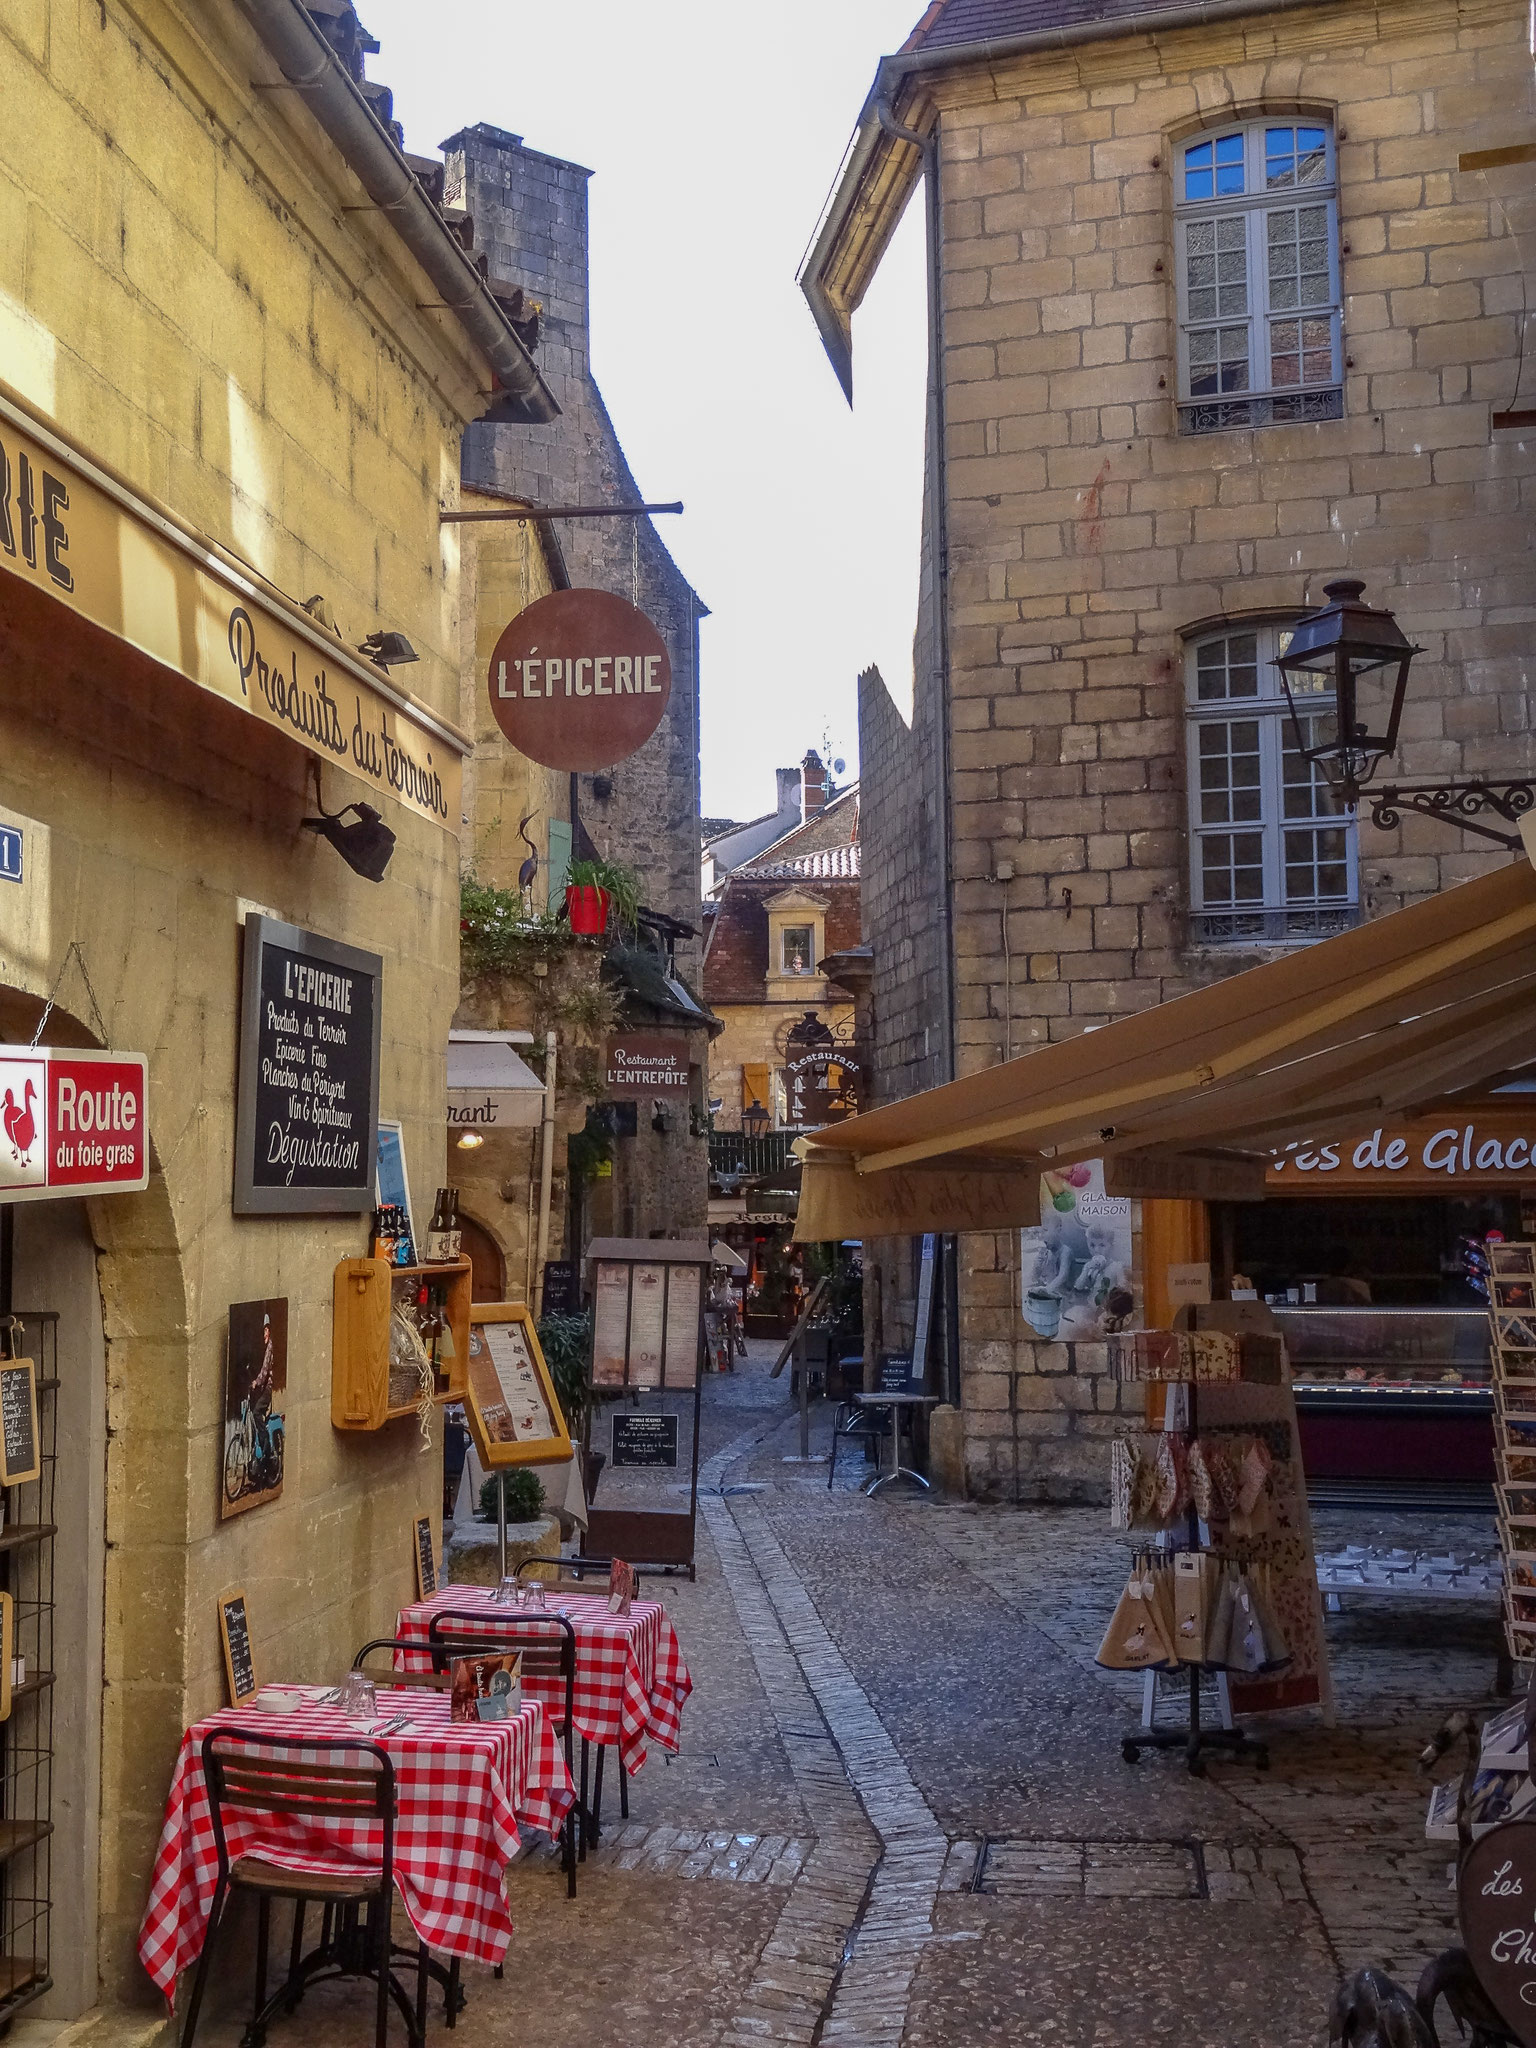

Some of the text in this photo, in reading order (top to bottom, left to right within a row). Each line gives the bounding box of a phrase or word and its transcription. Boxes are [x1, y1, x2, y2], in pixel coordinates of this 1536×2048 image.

[497, 646, 662, 699] L'ÉPICERIE
[228, 606, 448, 819] Produits du terroir
[285, 961, 353, 1014] L'EPICERIE
[267, 1000, 347, 1045] Produits du Terroir
[275, 1037, 328, 1069] Epicerie Fine
[614, 1048, 677, 1067] Restaurant
[787, 1052, 860, 1073] Restaurant
[262, 1057, 346, 1108] Planches du Périgord
[57, 1077, 137, 1132] Route
[288, 1094, 301, 1119] Vin
[312, 1096, 353, 1129] Spiritueux
[56, 1140, 135, 1172] du foie gras
[267, 1120, 360, 1187] Dégustation
[1352, 1127, 1409, 1170] de
[1081, 1205, 1128, 1215] MAISON
[1481, 1860, 1523, 1896] Les
